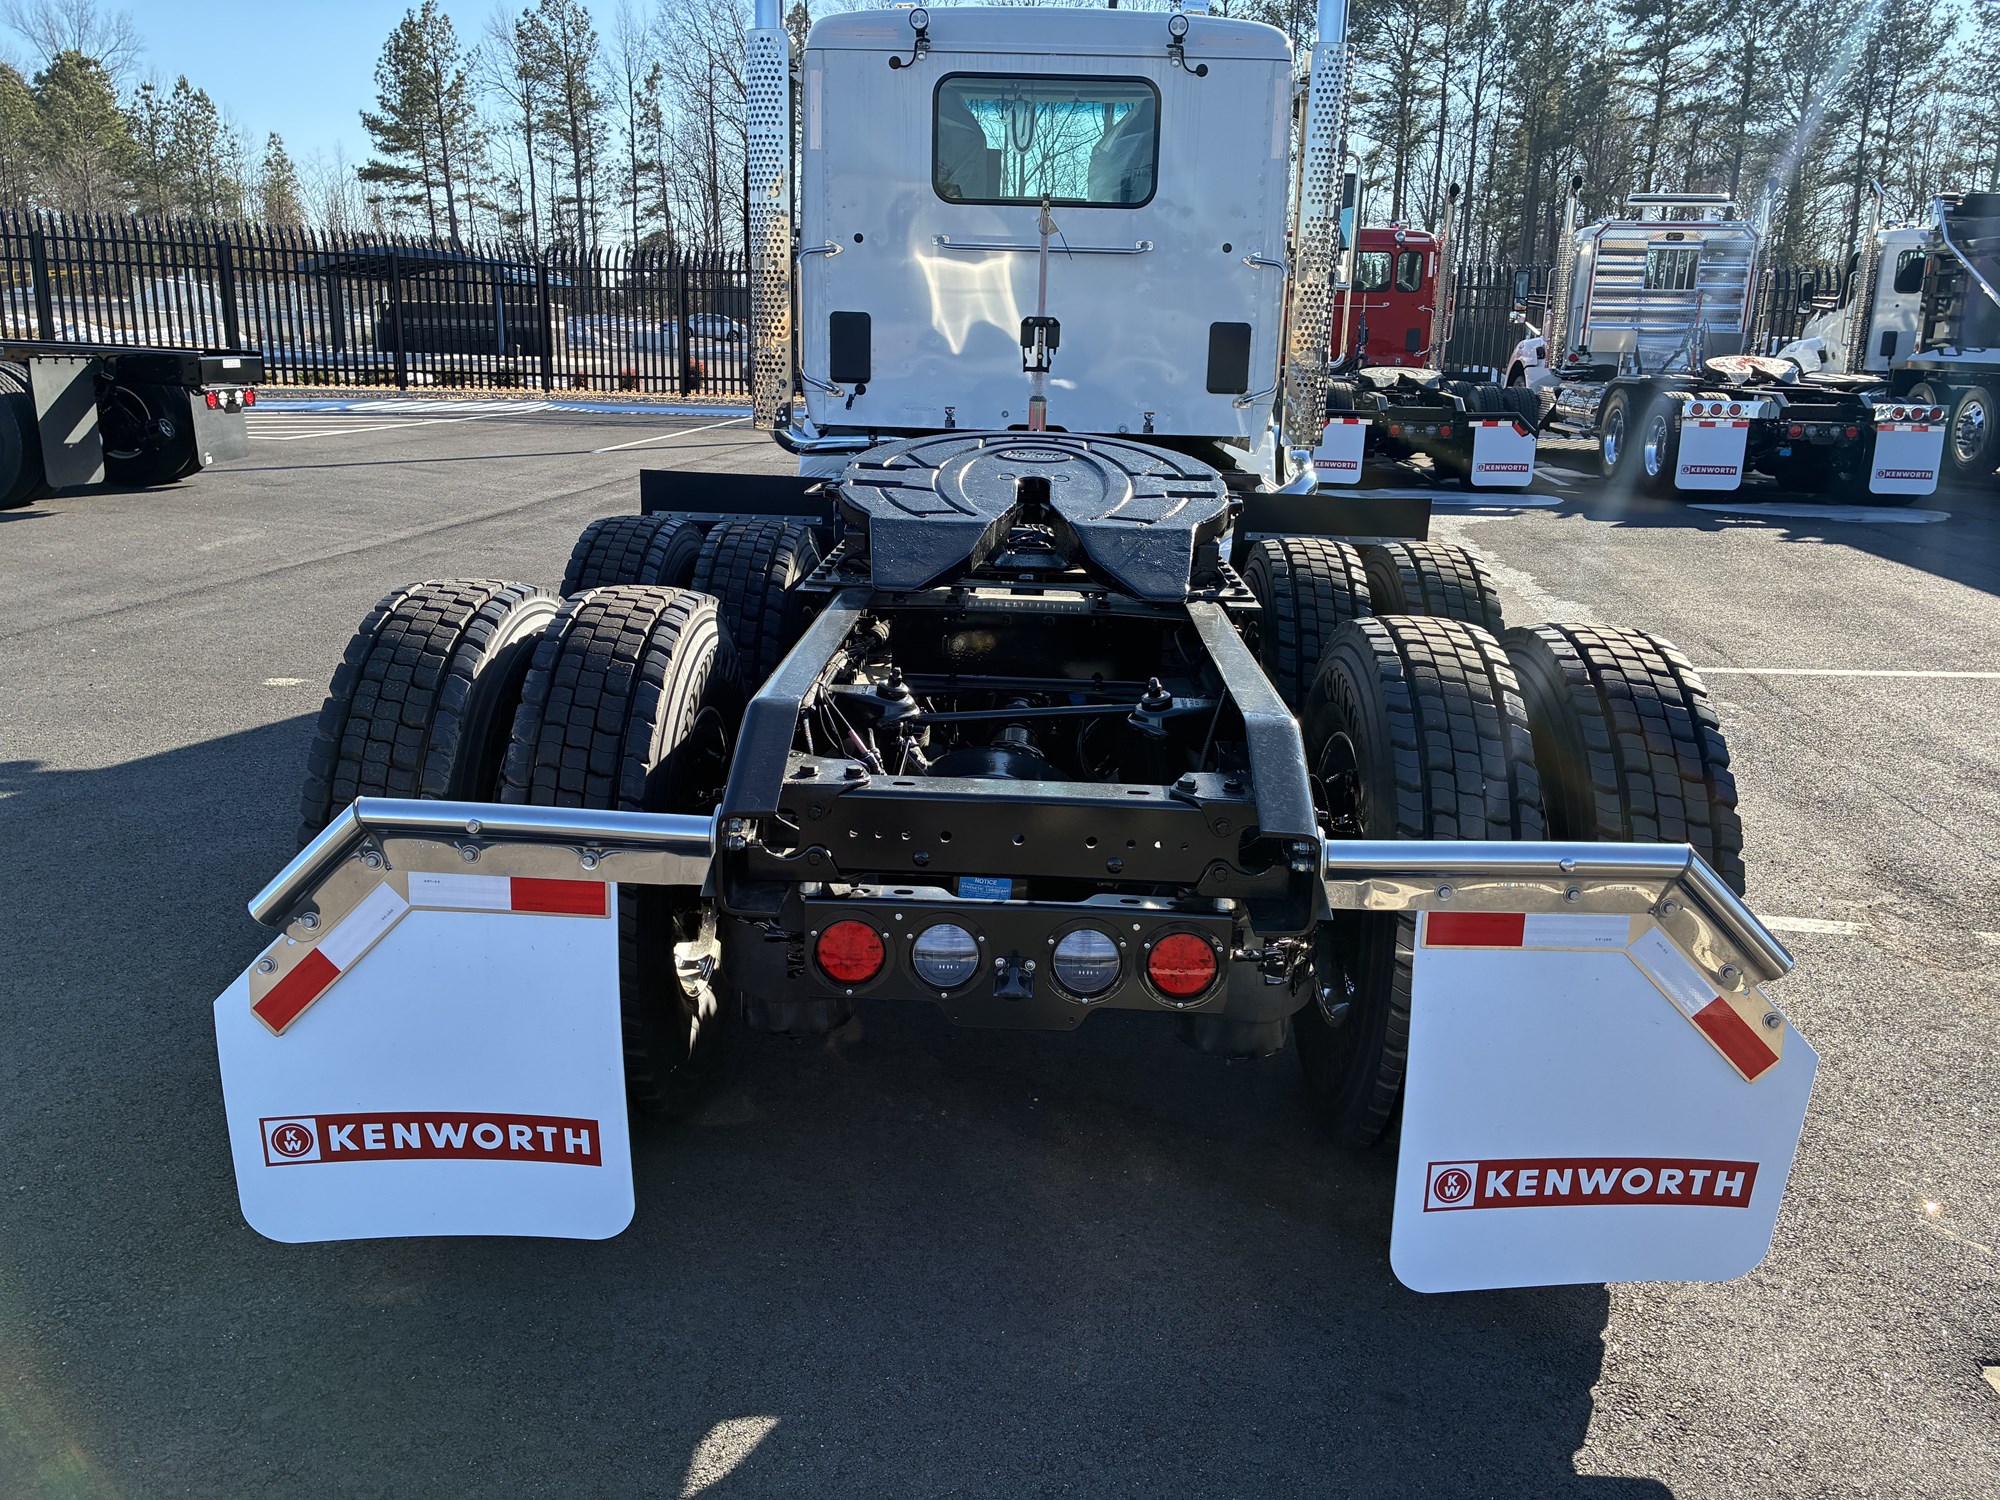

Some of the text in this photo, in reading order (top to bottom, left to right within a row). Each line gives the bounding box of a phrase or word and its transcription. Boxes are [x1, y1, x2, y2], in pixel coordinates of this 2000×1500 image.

[1314, 461, 1357, 469] KENWORTH
[1690, 466, 1736, 474] KENWORTH
[1885, 470, 1932, 478] KENWORTH
[328, 1122, 591, 1155] KENWORTH
[1485, 1167, 1746, 1198] KENWORTH
